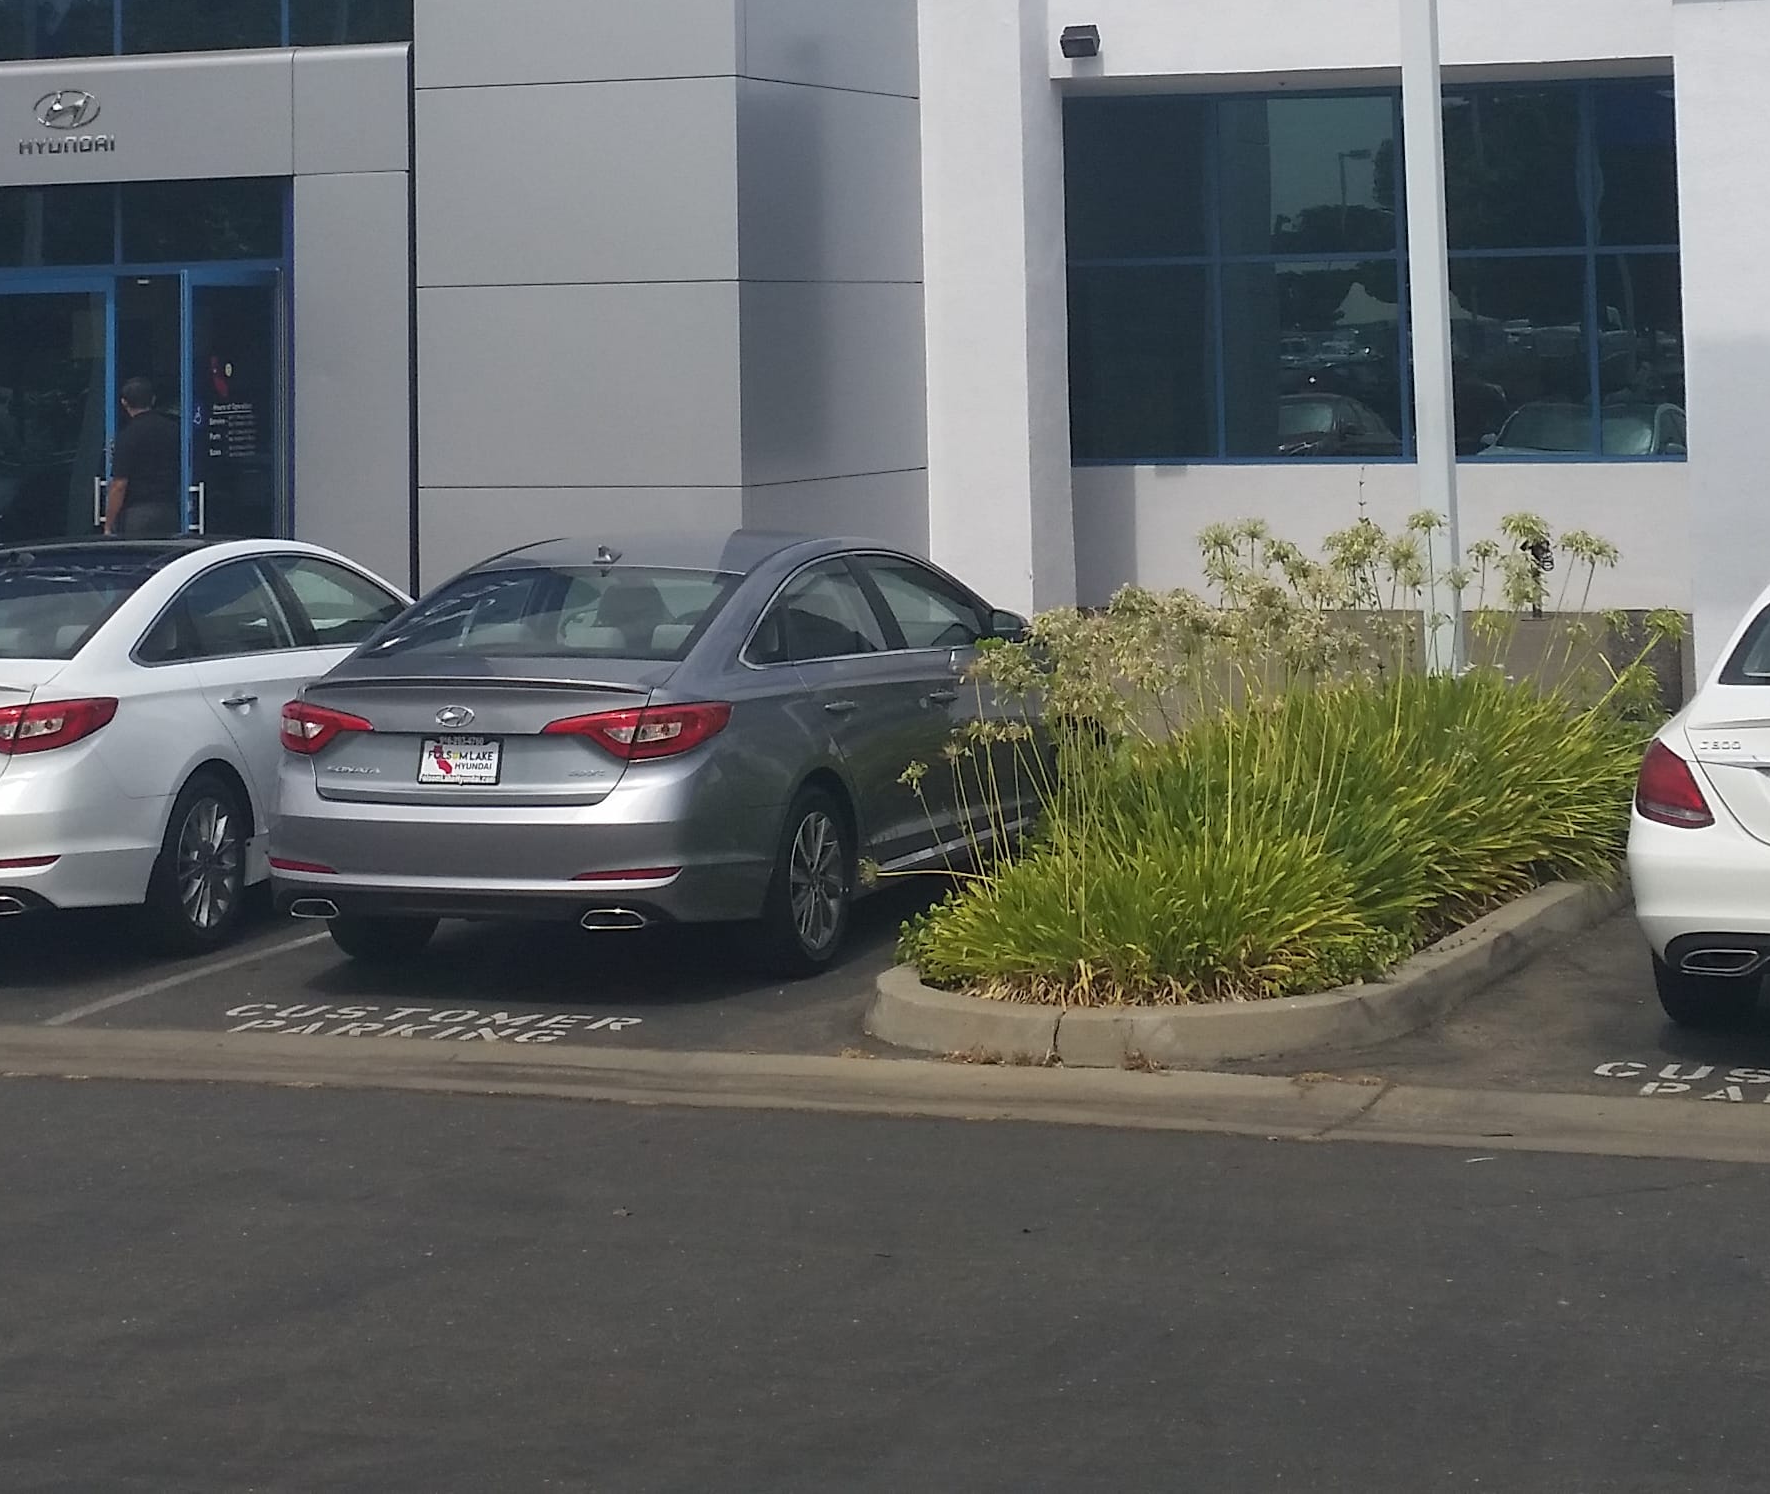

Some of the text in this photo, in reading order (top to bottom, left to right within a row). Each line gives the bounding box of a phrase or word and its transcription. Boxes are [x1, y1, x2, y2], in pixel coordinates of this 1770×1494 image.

[18, 135, 116, 155] HYUNDAI
[469, 751, 494, 760] LAKE
[454, 762, 492, 770] HYUNDAI
[225, 1003, 643, 1031] CUSTOMER
[228, 1019, 567, 1044] PARKING
